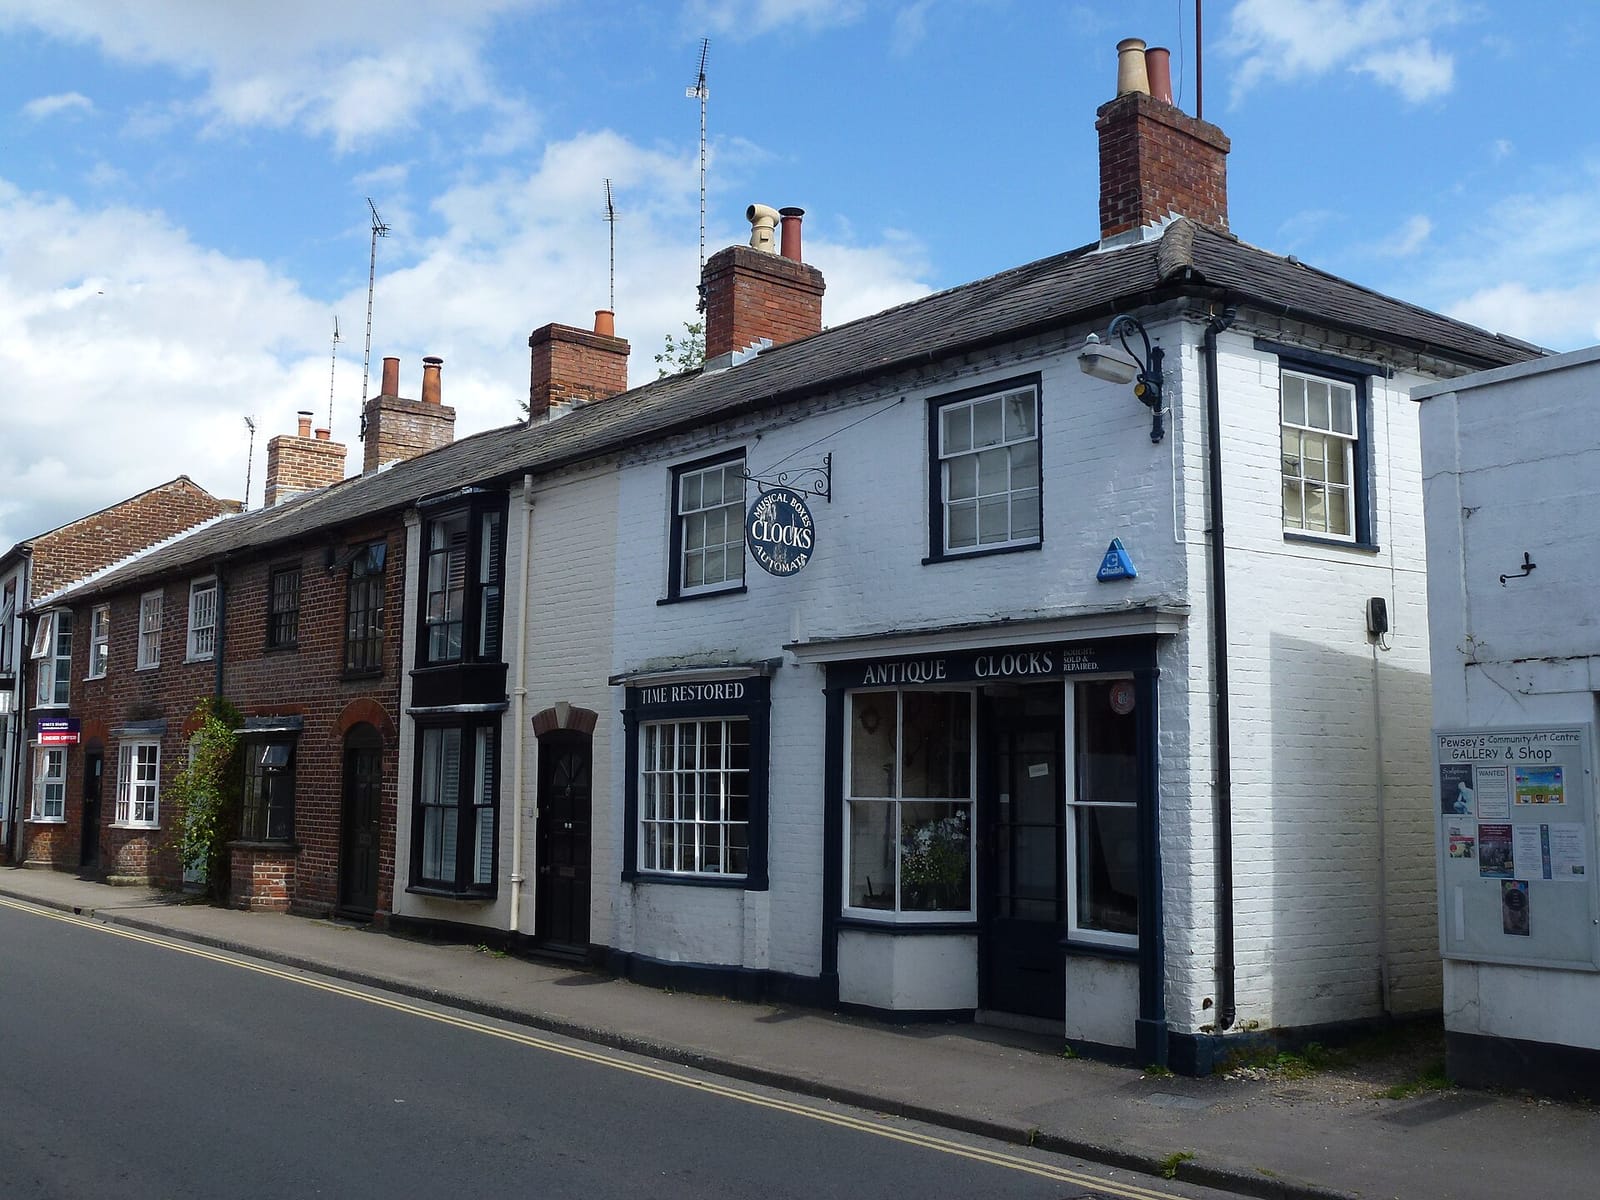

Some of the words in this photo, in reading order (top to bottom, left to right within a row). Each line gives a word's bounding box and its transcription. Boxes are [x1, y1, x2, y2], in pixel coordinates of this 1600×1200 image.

[753, 493, 788, 519] MUSICAL
[790, 497, 811, 527] BOXES
[752, 520, 812, 549] CLOCKS
[754, 545, 808, 572] AUTOMATA
[863, 659, 946, 684] ANTIQUE
[974, 651, 1053, 678] CLOCKS
[1063, 655, 1081, 663] SOLD
[641, 687, 667, 704] TIME
[671, 682, 744, 702] RESTORED
[1440, 736, 1485, 748] Pewsey's
[1487, 735, 1532, 744] Community
[1533, 733, 1547, 741] Art
[1550, 732, 1579, 741] Centre
[1452, 749, 1498, 759] GALLERY
[1505, 747, 1514, 760] &
[1518, 747, 1552, 762] Shop
